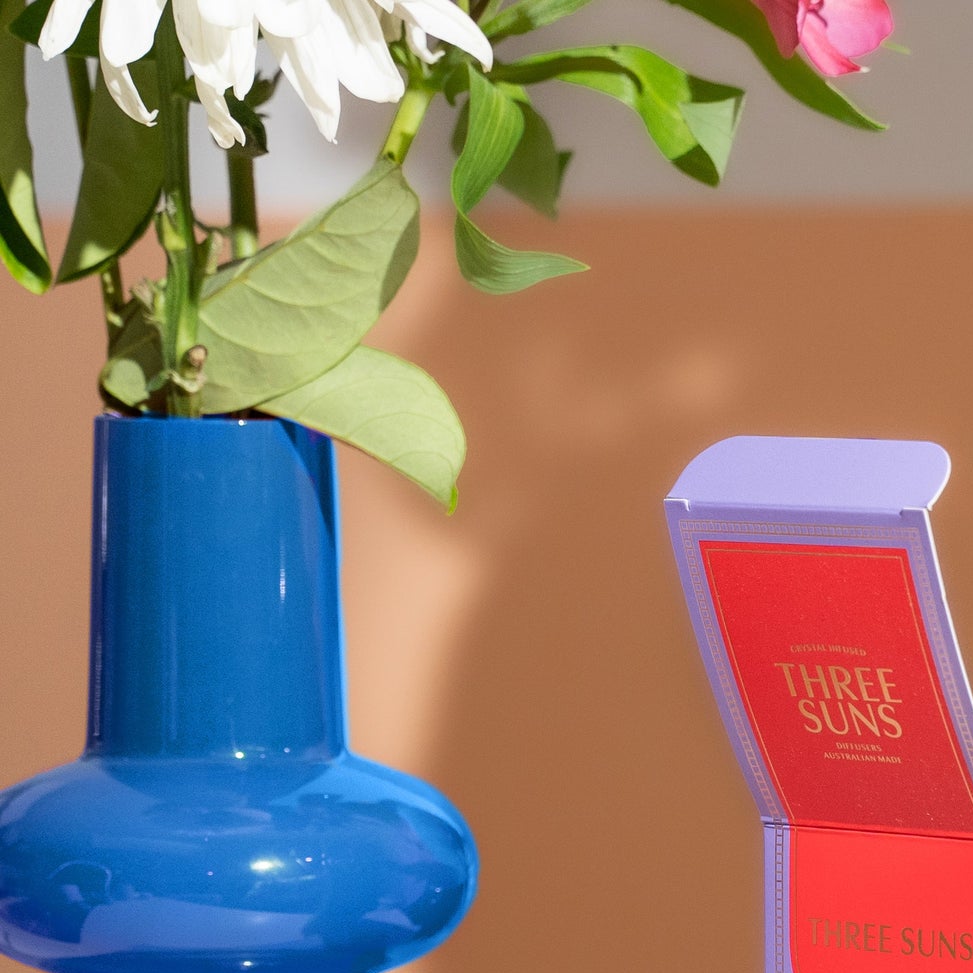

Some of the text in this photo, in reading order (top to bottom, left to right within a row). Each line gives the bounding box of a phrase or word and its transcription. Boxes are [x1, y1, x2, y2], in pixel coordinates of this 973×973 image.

[790, 644, 867, 657] CRYSTAL INFUSED
[774, 663, 903, 703] THREE
[798, 699, 903, 739] SUNS
[824, 752, 902, 764] AUSTRALIAN MADE
[836, 742, 882, 752] DIFFUSERS
[808, 918, 973, 961] THREE SUNS
